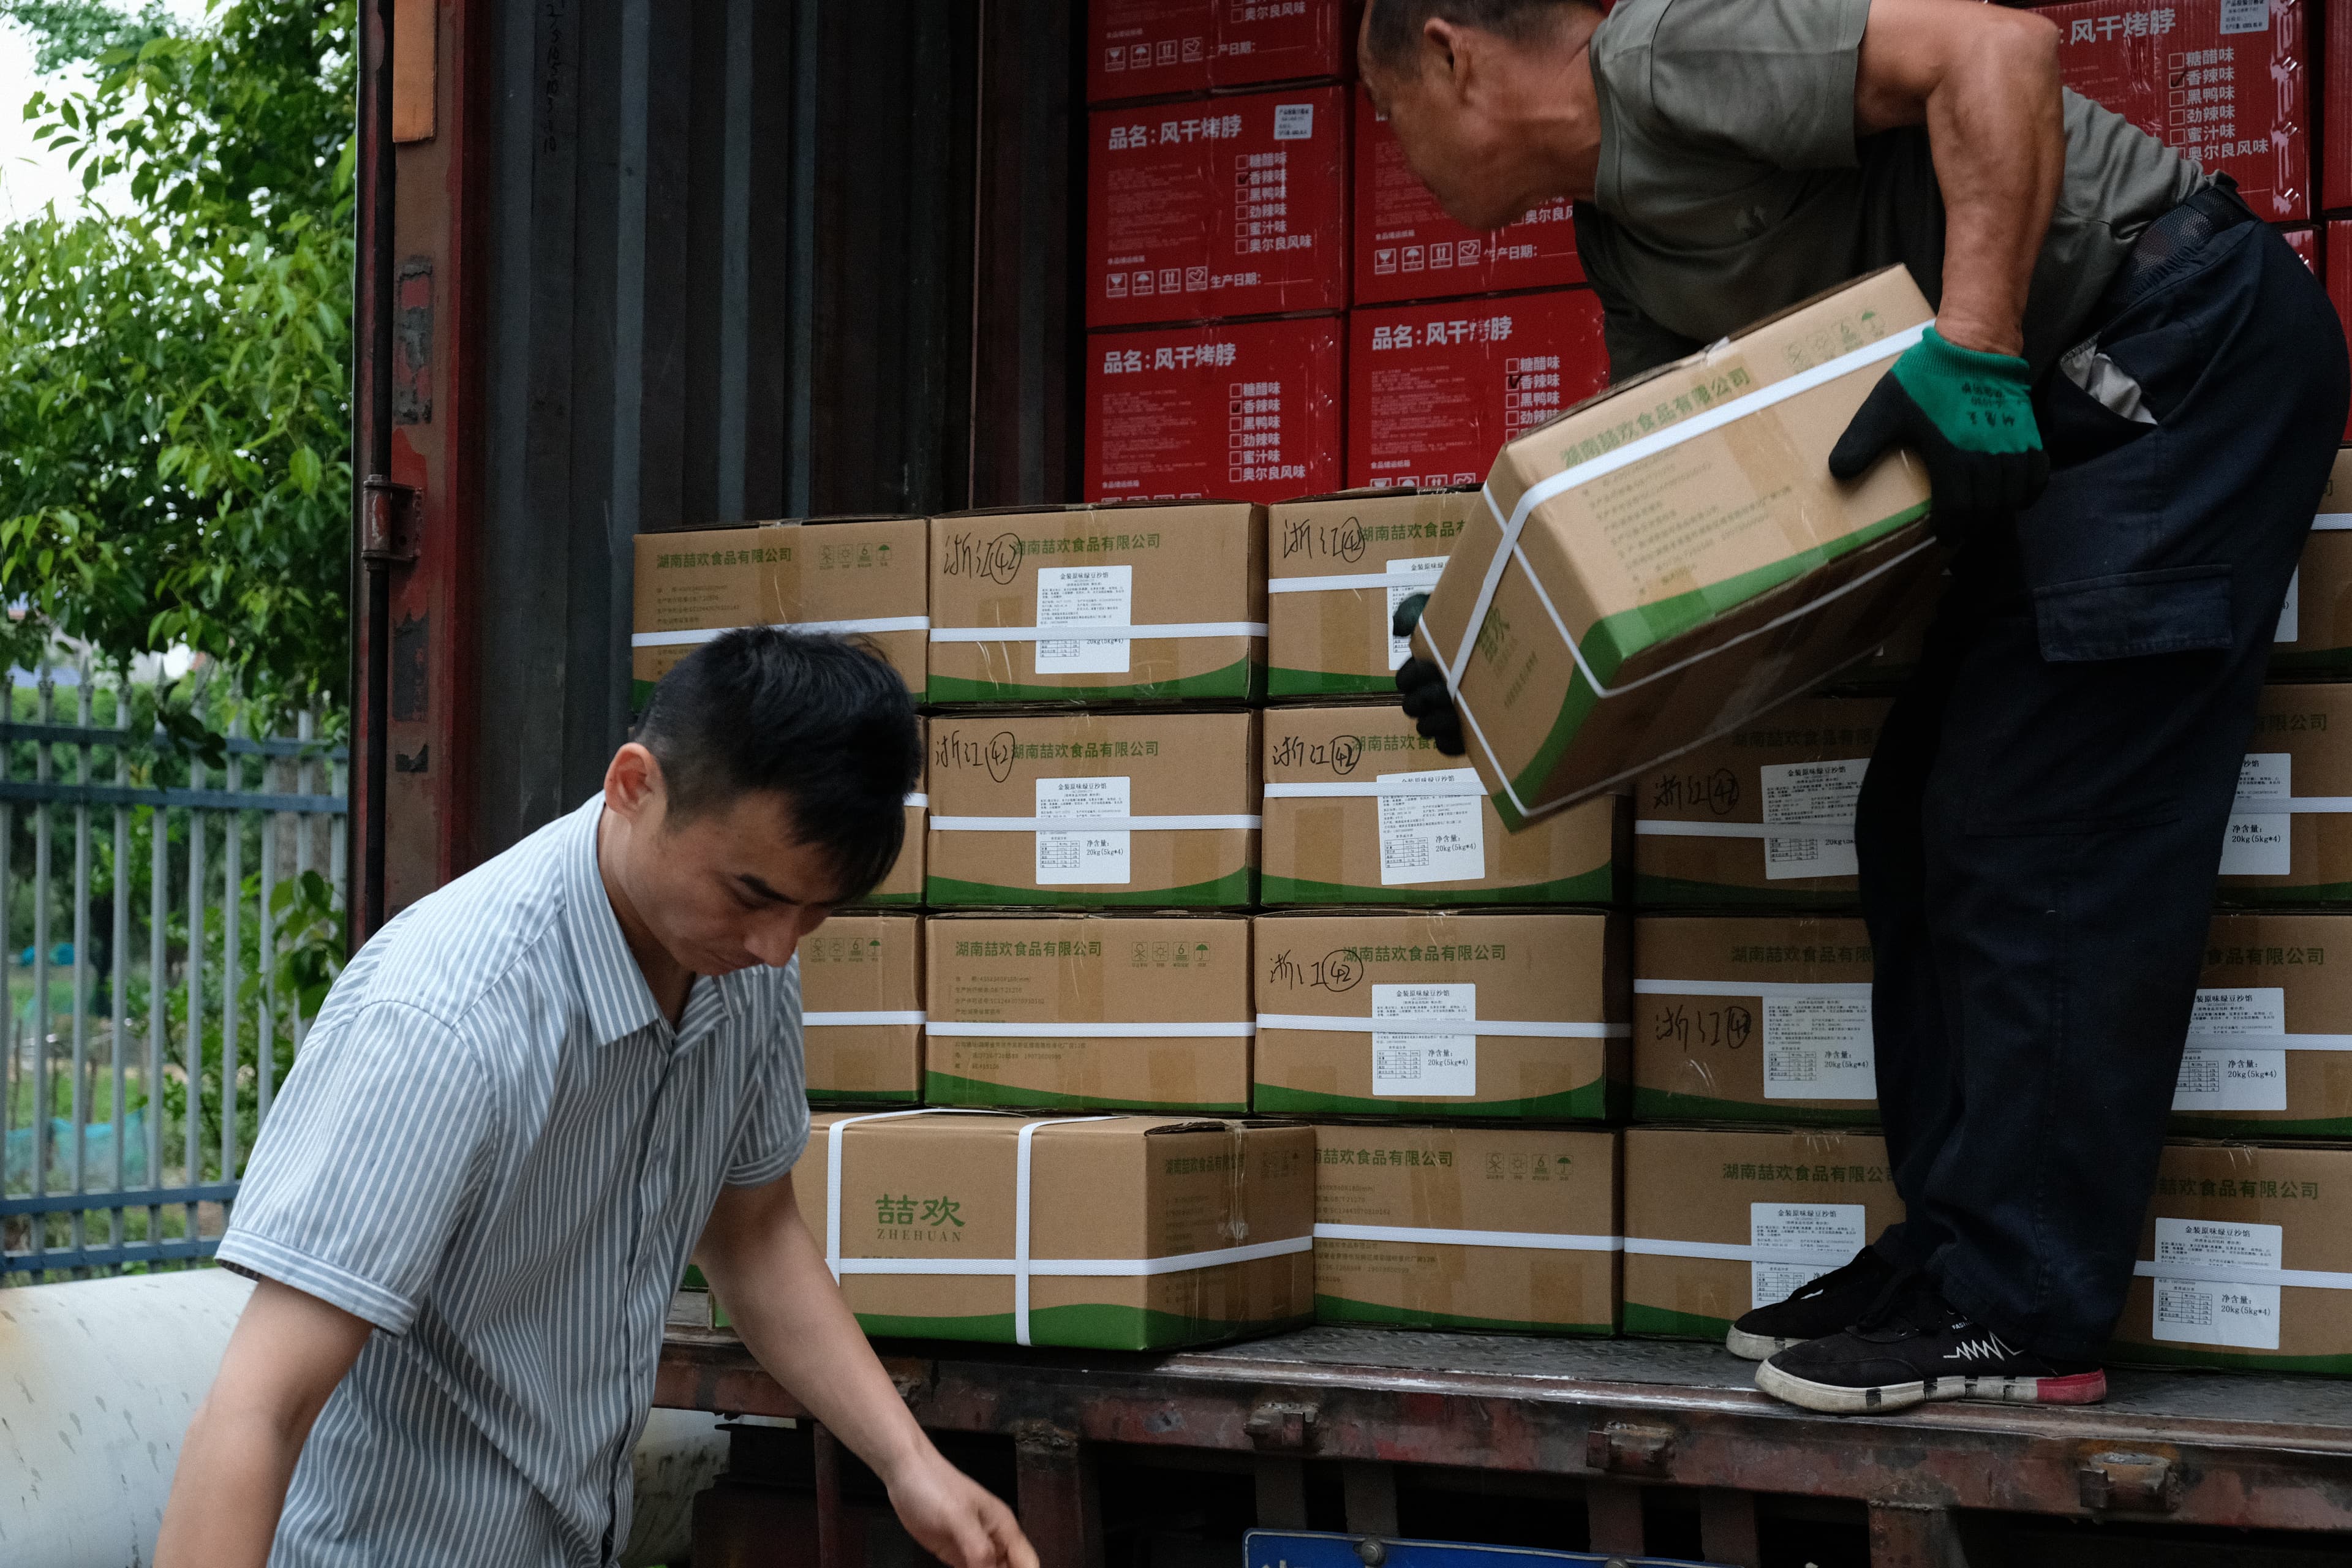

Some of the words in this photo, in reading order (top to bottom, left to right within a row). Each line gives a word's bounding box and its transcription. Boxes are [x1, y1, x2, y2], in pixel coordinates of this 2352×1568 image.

[1245, 2, 1306, 21] 奥尔良风味
[1210, 40, 1256, 58] 产日期：
[2186, 47, 2234, 67] 糖醋味
[2186, 67, 2235, 86] 香辣味
[2187, 86, 2235, 105] 黑鸭味
[2187, 105, 2235, 124] 劲辣味
[2187, 124, 2235, 143] 蜜汁味
[2188, 139, 2269, 162] 奥尔良风味
[1249, 152, 1287, 168] 糖醋味
[1249, 169, 1287, 186] 香辣味
[1249, 186, 1287, 202] 黑鸭味
[1249, 203, 1287, 219] 劲辣味
[1249, 220, 1287, 236] 蜜汁味
[1249, 235, 1313, 254] 奥尔良风味
[1520, 355, 1560, 372] 糖醋味
[1243, 382, 1281, 398] 糖醋味
[1520, 374, 1560, 390] 香辣味
[1243, 398, 1281, 415] 香辣味
[1520, 391, 1560, 408] 黑鸭味
[1243, 415, 1281, 431] 黑鸭味
[1243, 432, 1281, 448] 劲辣味
[1243, 450, 1281, 465] 蜜汁味
[1243, 465, 1306, 482] 奥尔良风味
[1014, 533, 1160, 556] 湖南喆欢食品有限公司
[657, 548, 791, 568] 湖南喆欢食品有限公司
[1012, 741, 1159, 760] 湖南喆欢食品有限公司
[2232, 824, 2263, 833] 净含量：
[956, 941, 1102, 958] 湖南喆欢食品有限公司
[1343, 944, 1506, 962] 湖南喆欢食品有限公司
[2205, 948, 2324, 965] 食品有限公司
[2195, 994, 2252, 1003] 装原味绿豆沙馅
[1825, 1050, 1852, 1059] 净含量：
[875, 1194, 965, 1227] 喆欢
[876, 1229, 961, 1242] ZHEHUAN
[2185, 1226, 2250, 1237] 金装原味绿豆沙馅
[2222, 1294, 2252, 1304] 净含量：
